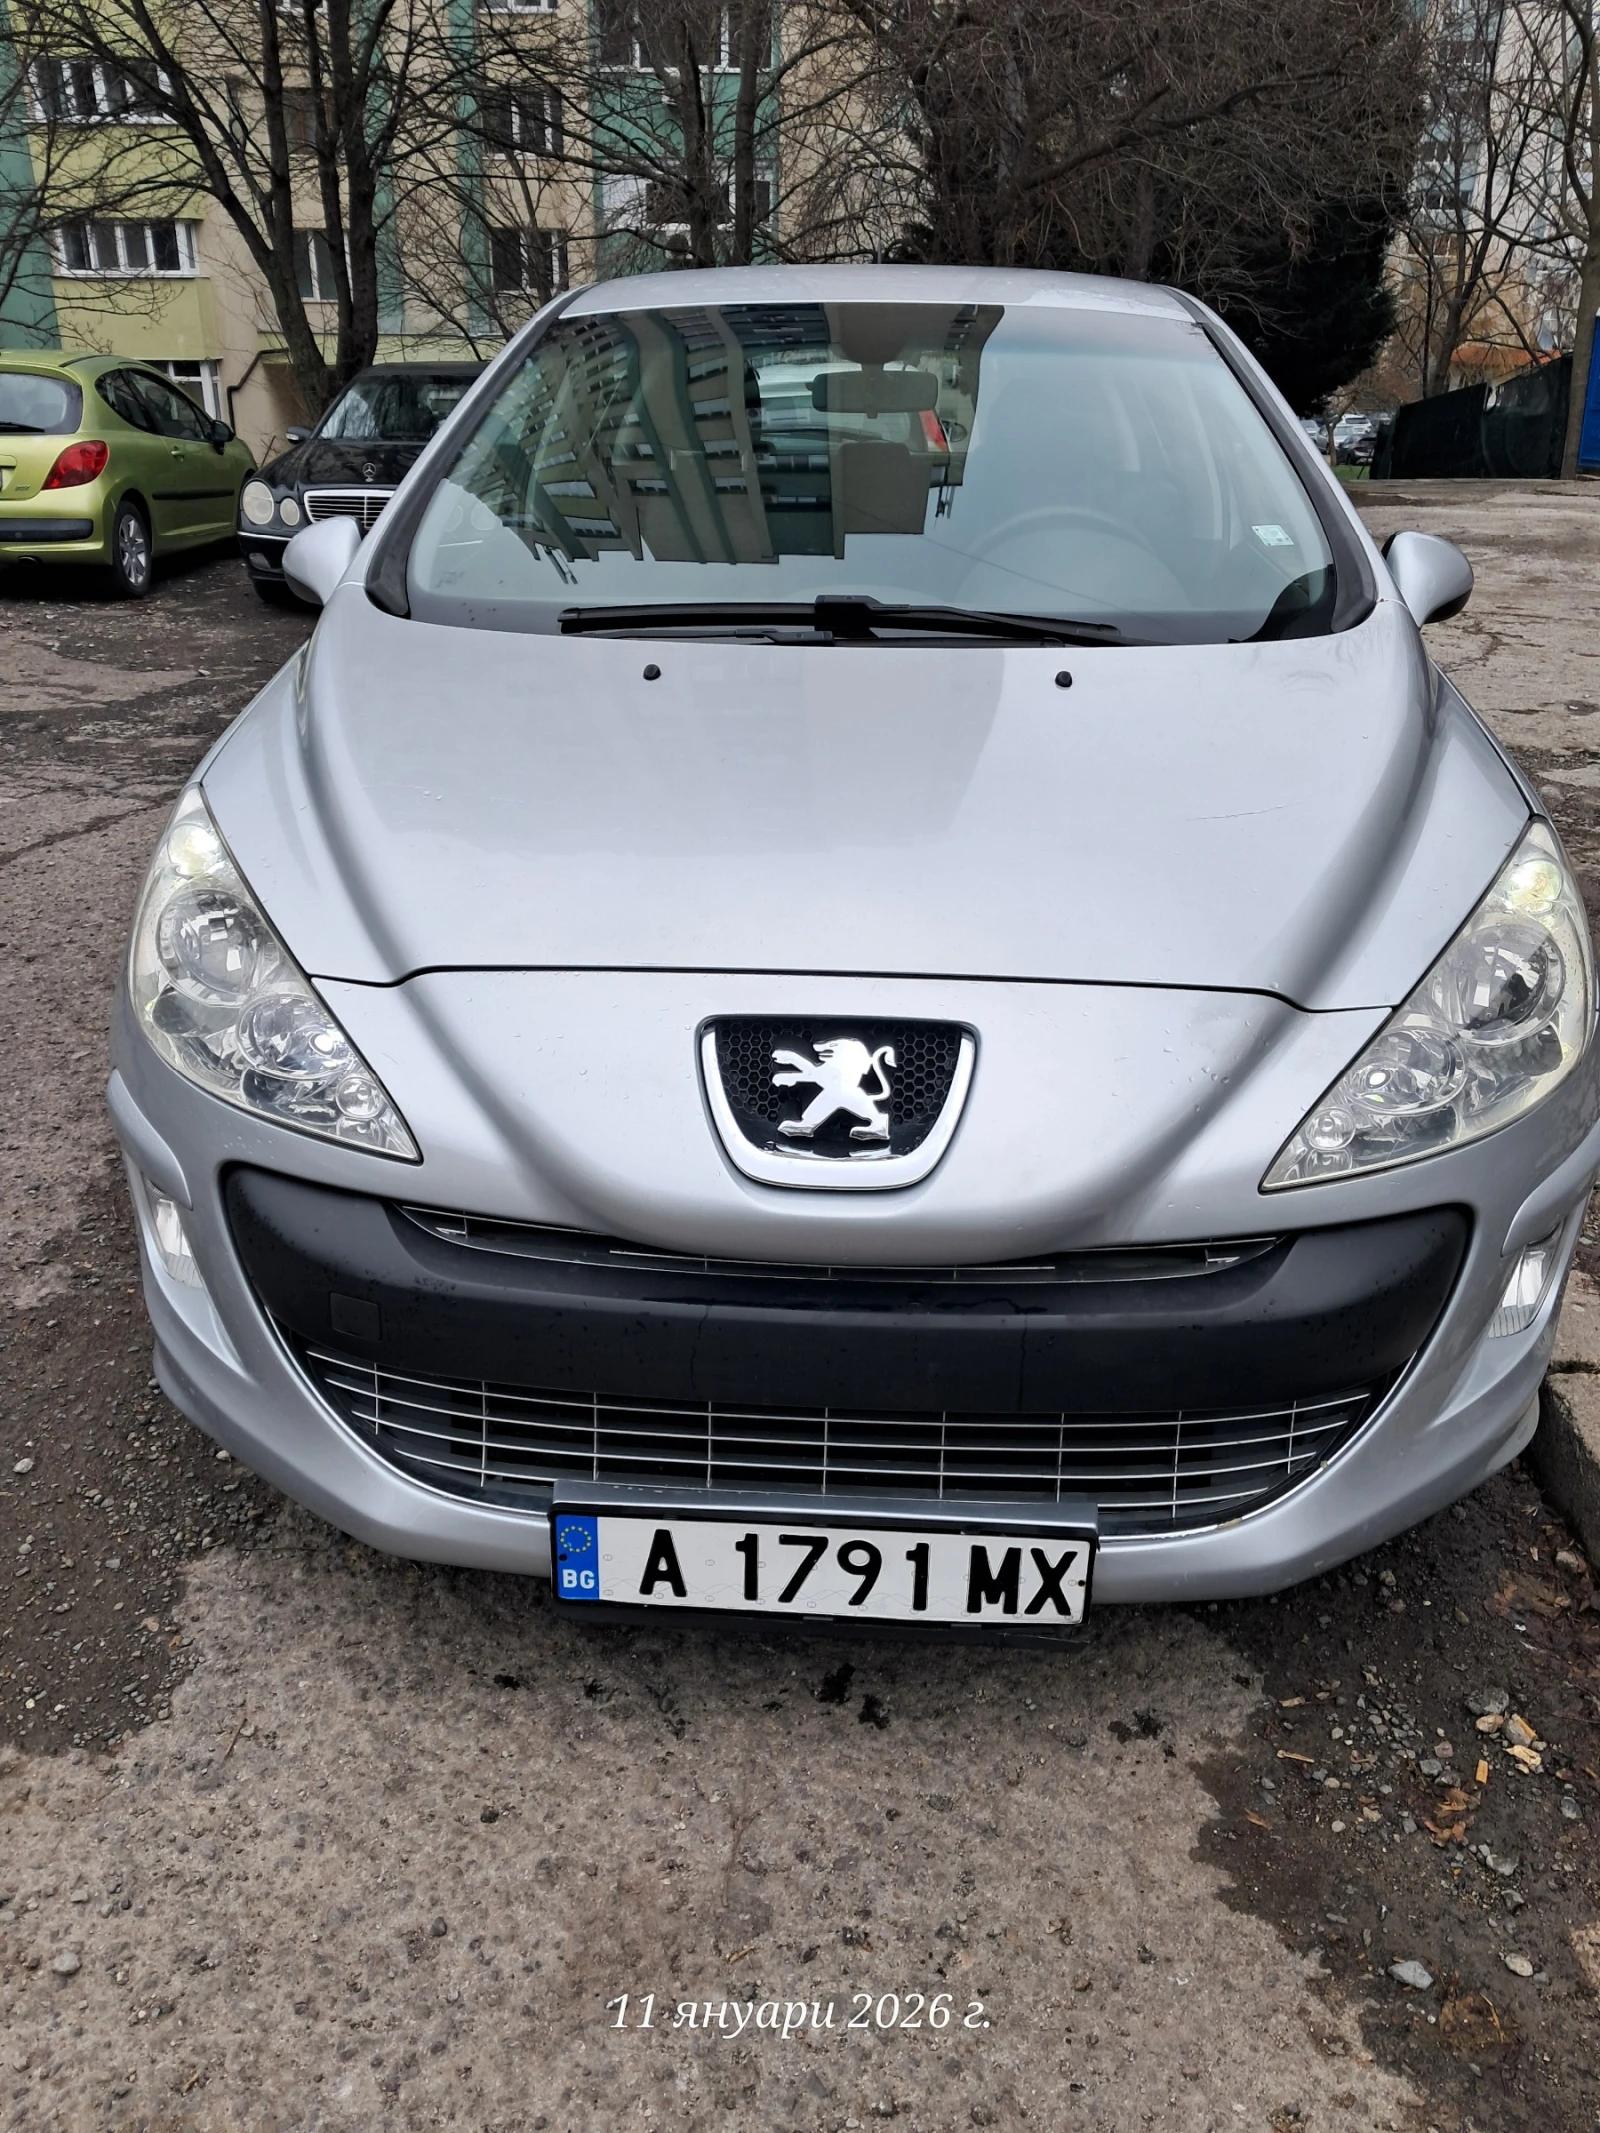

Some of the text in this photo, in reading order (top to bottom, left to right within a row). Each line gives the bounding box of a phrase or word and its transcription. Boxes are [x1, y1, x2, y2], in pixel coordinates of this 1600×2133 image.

[562, 1568, 595, 1590] BG
[638, 1528, 1079, 1617] A 1791 MX
